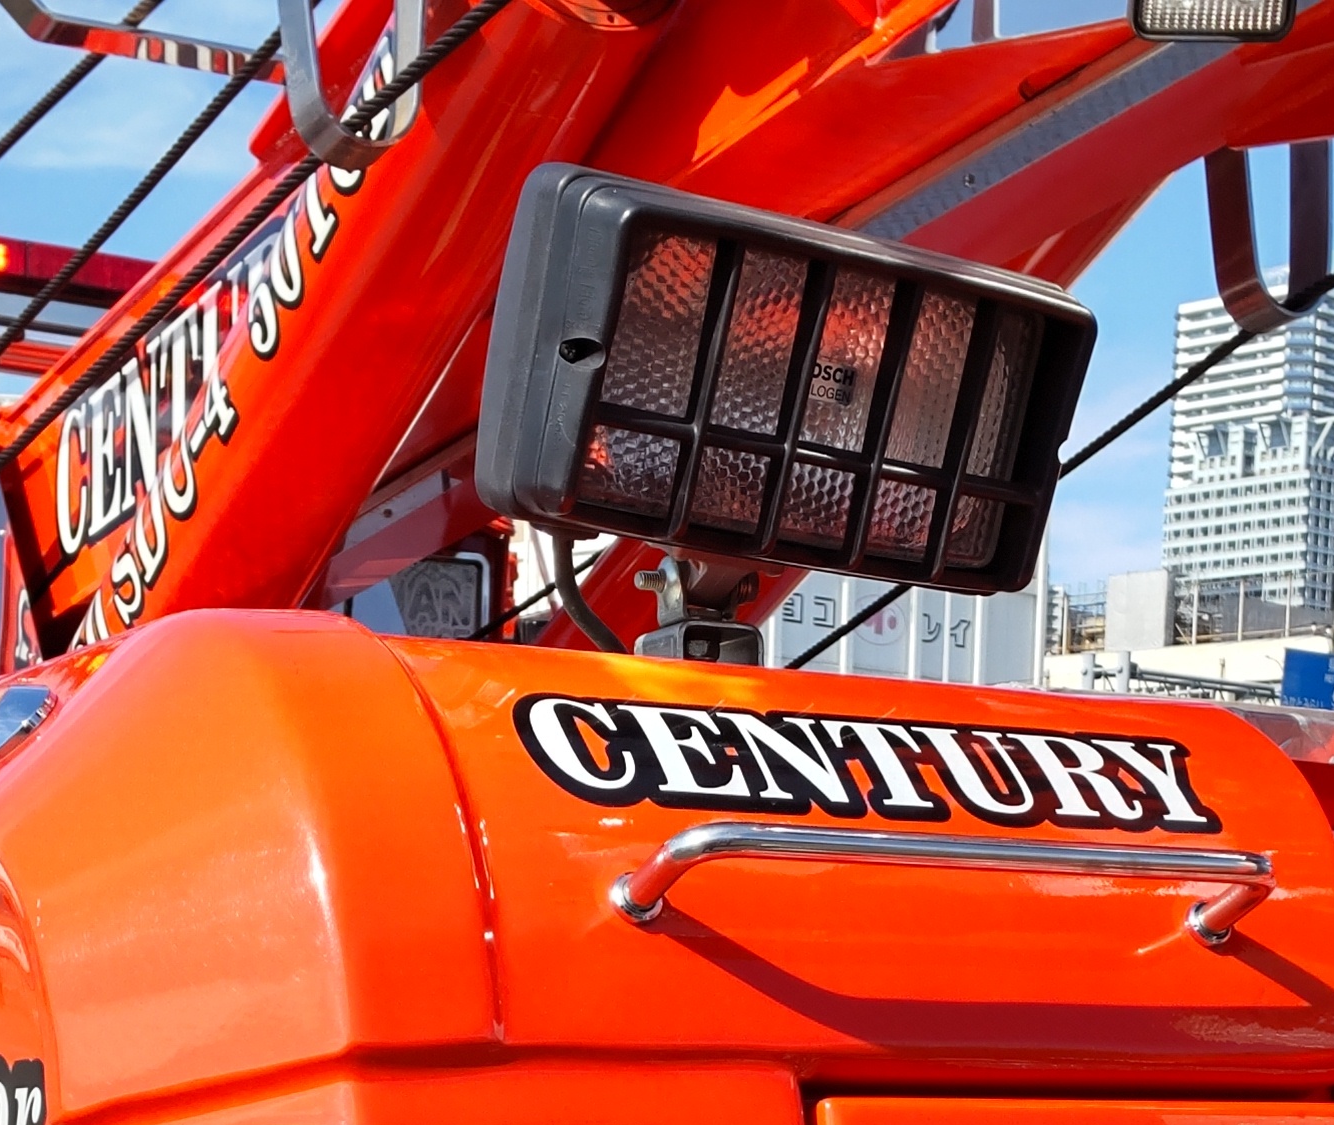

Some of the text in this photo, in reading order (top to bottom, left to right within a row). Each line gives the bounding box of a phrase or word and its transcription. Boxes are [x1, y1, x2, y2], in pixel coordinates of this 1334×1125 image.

[813, 363, 854, 386] OSCH
[811, 384, 851, 401] LOGEN
[527, 697, 1213, 826] CENTURY
